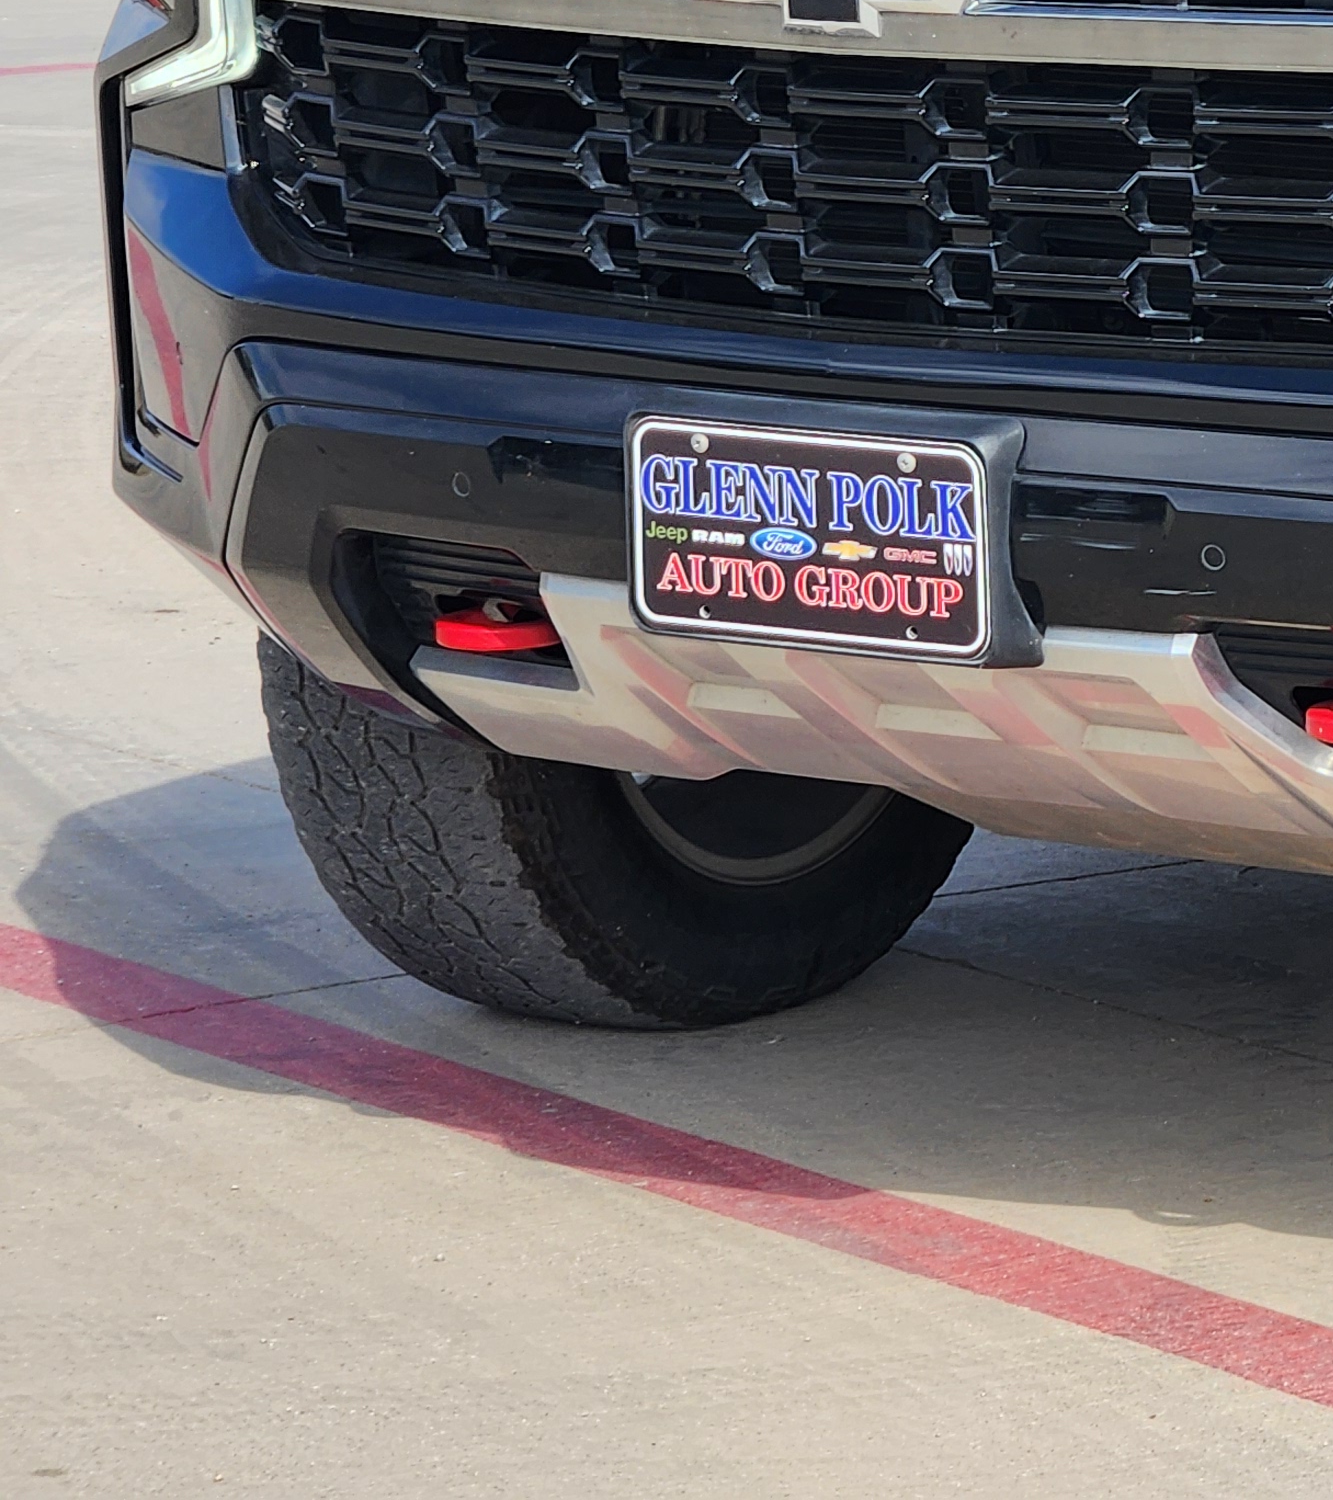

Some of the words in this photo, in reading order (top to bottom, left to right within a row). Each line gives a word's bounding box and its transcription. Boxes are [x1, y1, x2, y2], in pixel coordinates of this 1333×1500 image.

[641, 453, 820, 528] GLENN
[827, 470, 976, 541] POLK
[645, 520, 689, 544] Jeep
[691, 528, 745, 546] RAM
[762, 530, 806, 556] Ford
[883, 546, 938, 566] GMC
[657, 551, 787, 602] AUTO
[794, 564, 964, 619] GROUP
